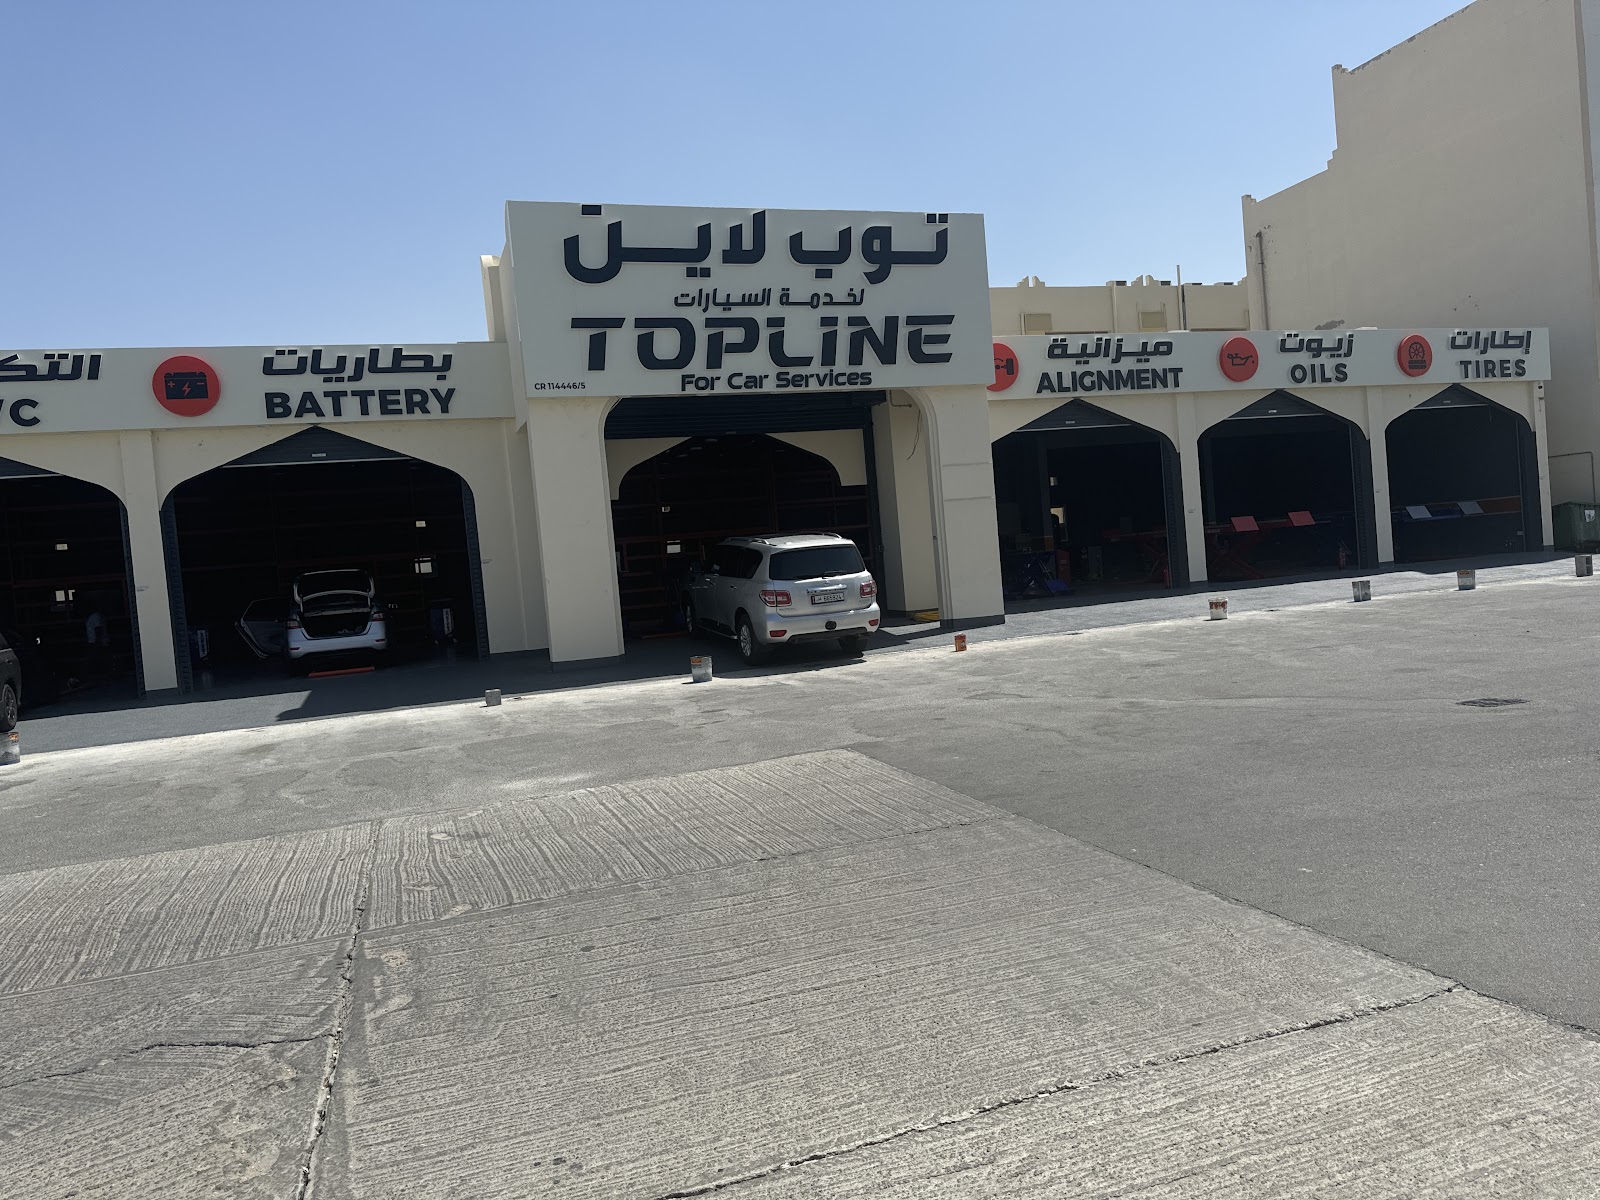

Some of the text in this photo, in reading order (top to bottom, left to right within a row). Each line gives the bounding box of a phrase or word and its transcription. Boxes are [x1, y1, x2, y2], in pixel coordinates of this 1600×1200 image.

[563, 204, 949, 285] توب لاين
[673, 287, 865, 313] لخدمة السيارات
[570, 314, 955, 373] TOPLINE
[1047, 336, 1174, 365] ميزانية
[1279, 333, 1355, 359] زيوت
[1450, 330, 1532, 355] إطارات
[262, 347, 453, 383] بطاريات
[1290, 362, 1348, 384] OILS
[1459, 359, 1527, 379] TIRES
[534, 381, 586, 391] CR 114446/5
[681, 368, 872, 392] For Car Services
[1036, 367, 1183, 396] ALIGNMENT
[264, 387, 456, 419] BATTERY
